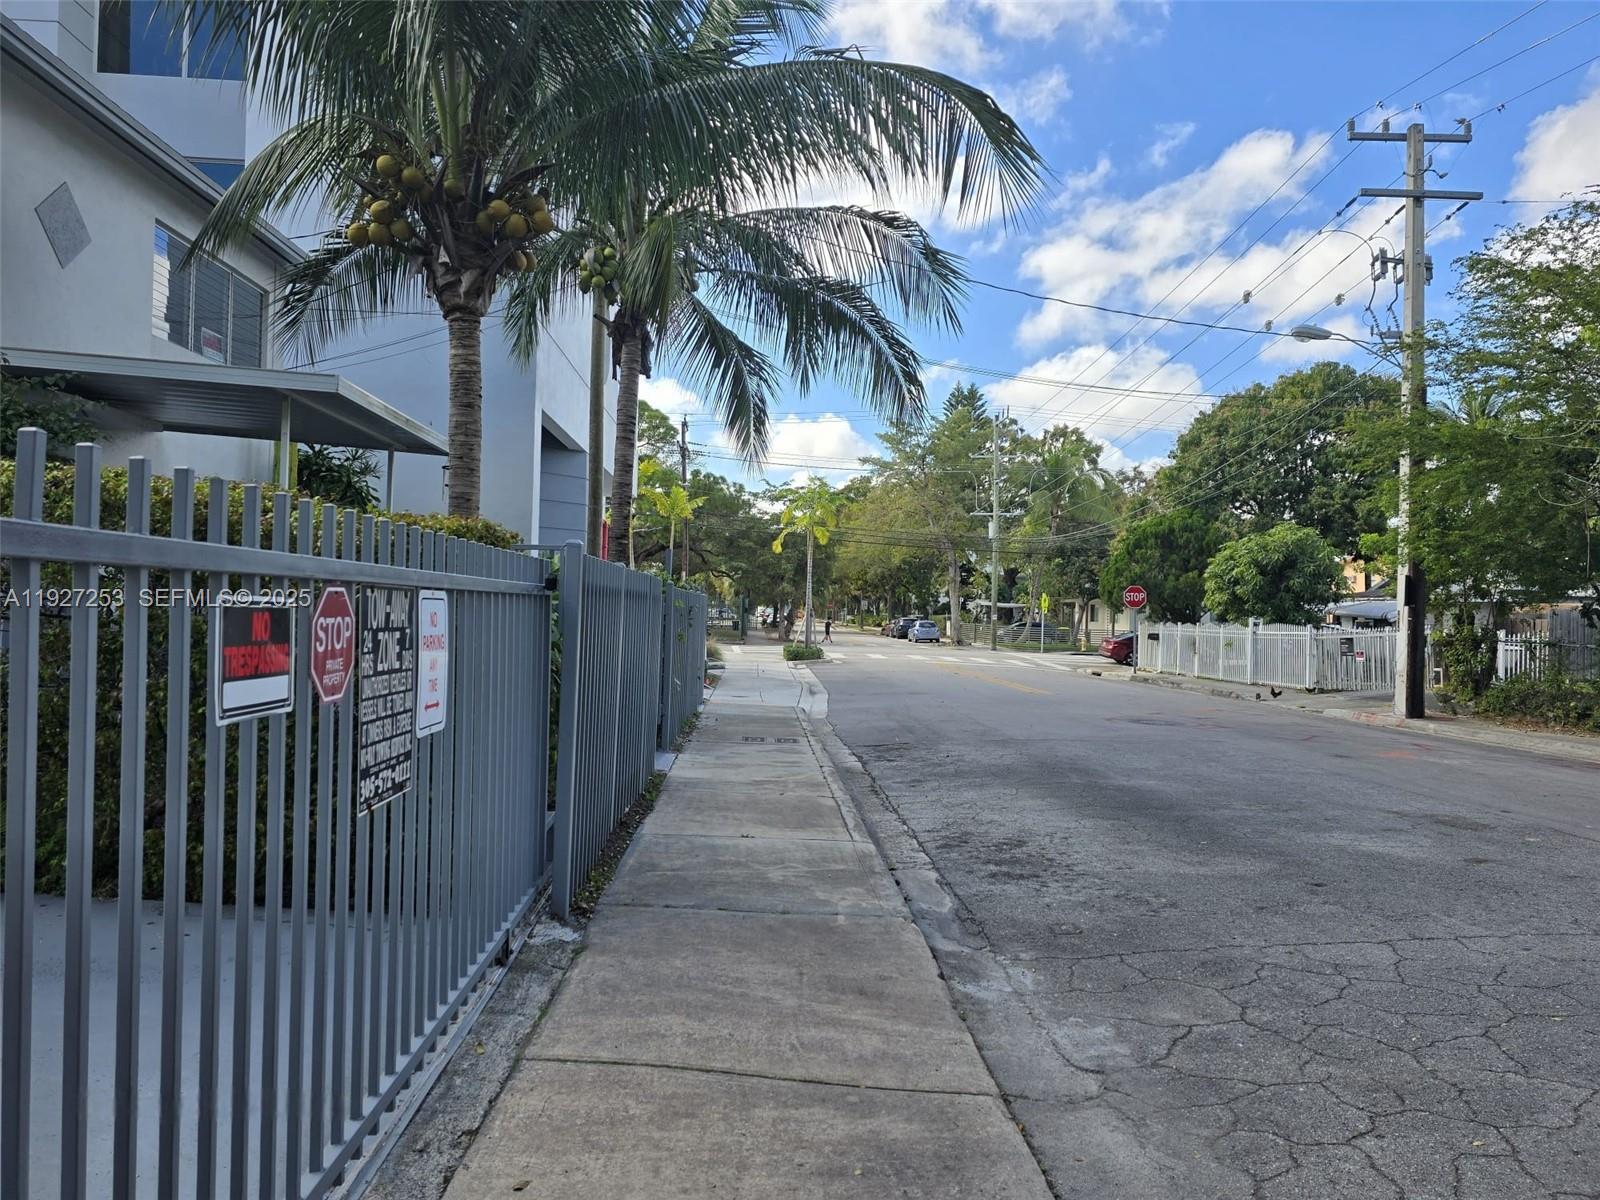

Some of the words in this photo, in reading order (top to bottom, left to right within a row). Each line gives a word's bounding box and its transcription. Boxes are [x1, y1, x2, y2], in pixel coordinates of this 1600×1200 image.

[366, 588, 410, 629] TOW-AWAY
[1125, 592, 1145, 602] STOP
[252, 611, 271, 641] NO
[430, 611, 438, 628] NO
[316, 616, 352, 653] STOP
[363, 630, 372, 653] 24
[405, 628, 410, 649] 7
[423, 633, 445, 652] PARKING
[224, 643, 289, 679] TRESPASSING
[377, 631, 400, 671] ZONE
[325, 658, 345, 670] PRIVATE
[361, 653, 373, 677] HRS
[323, 672, 345, 688] PROPERTY
